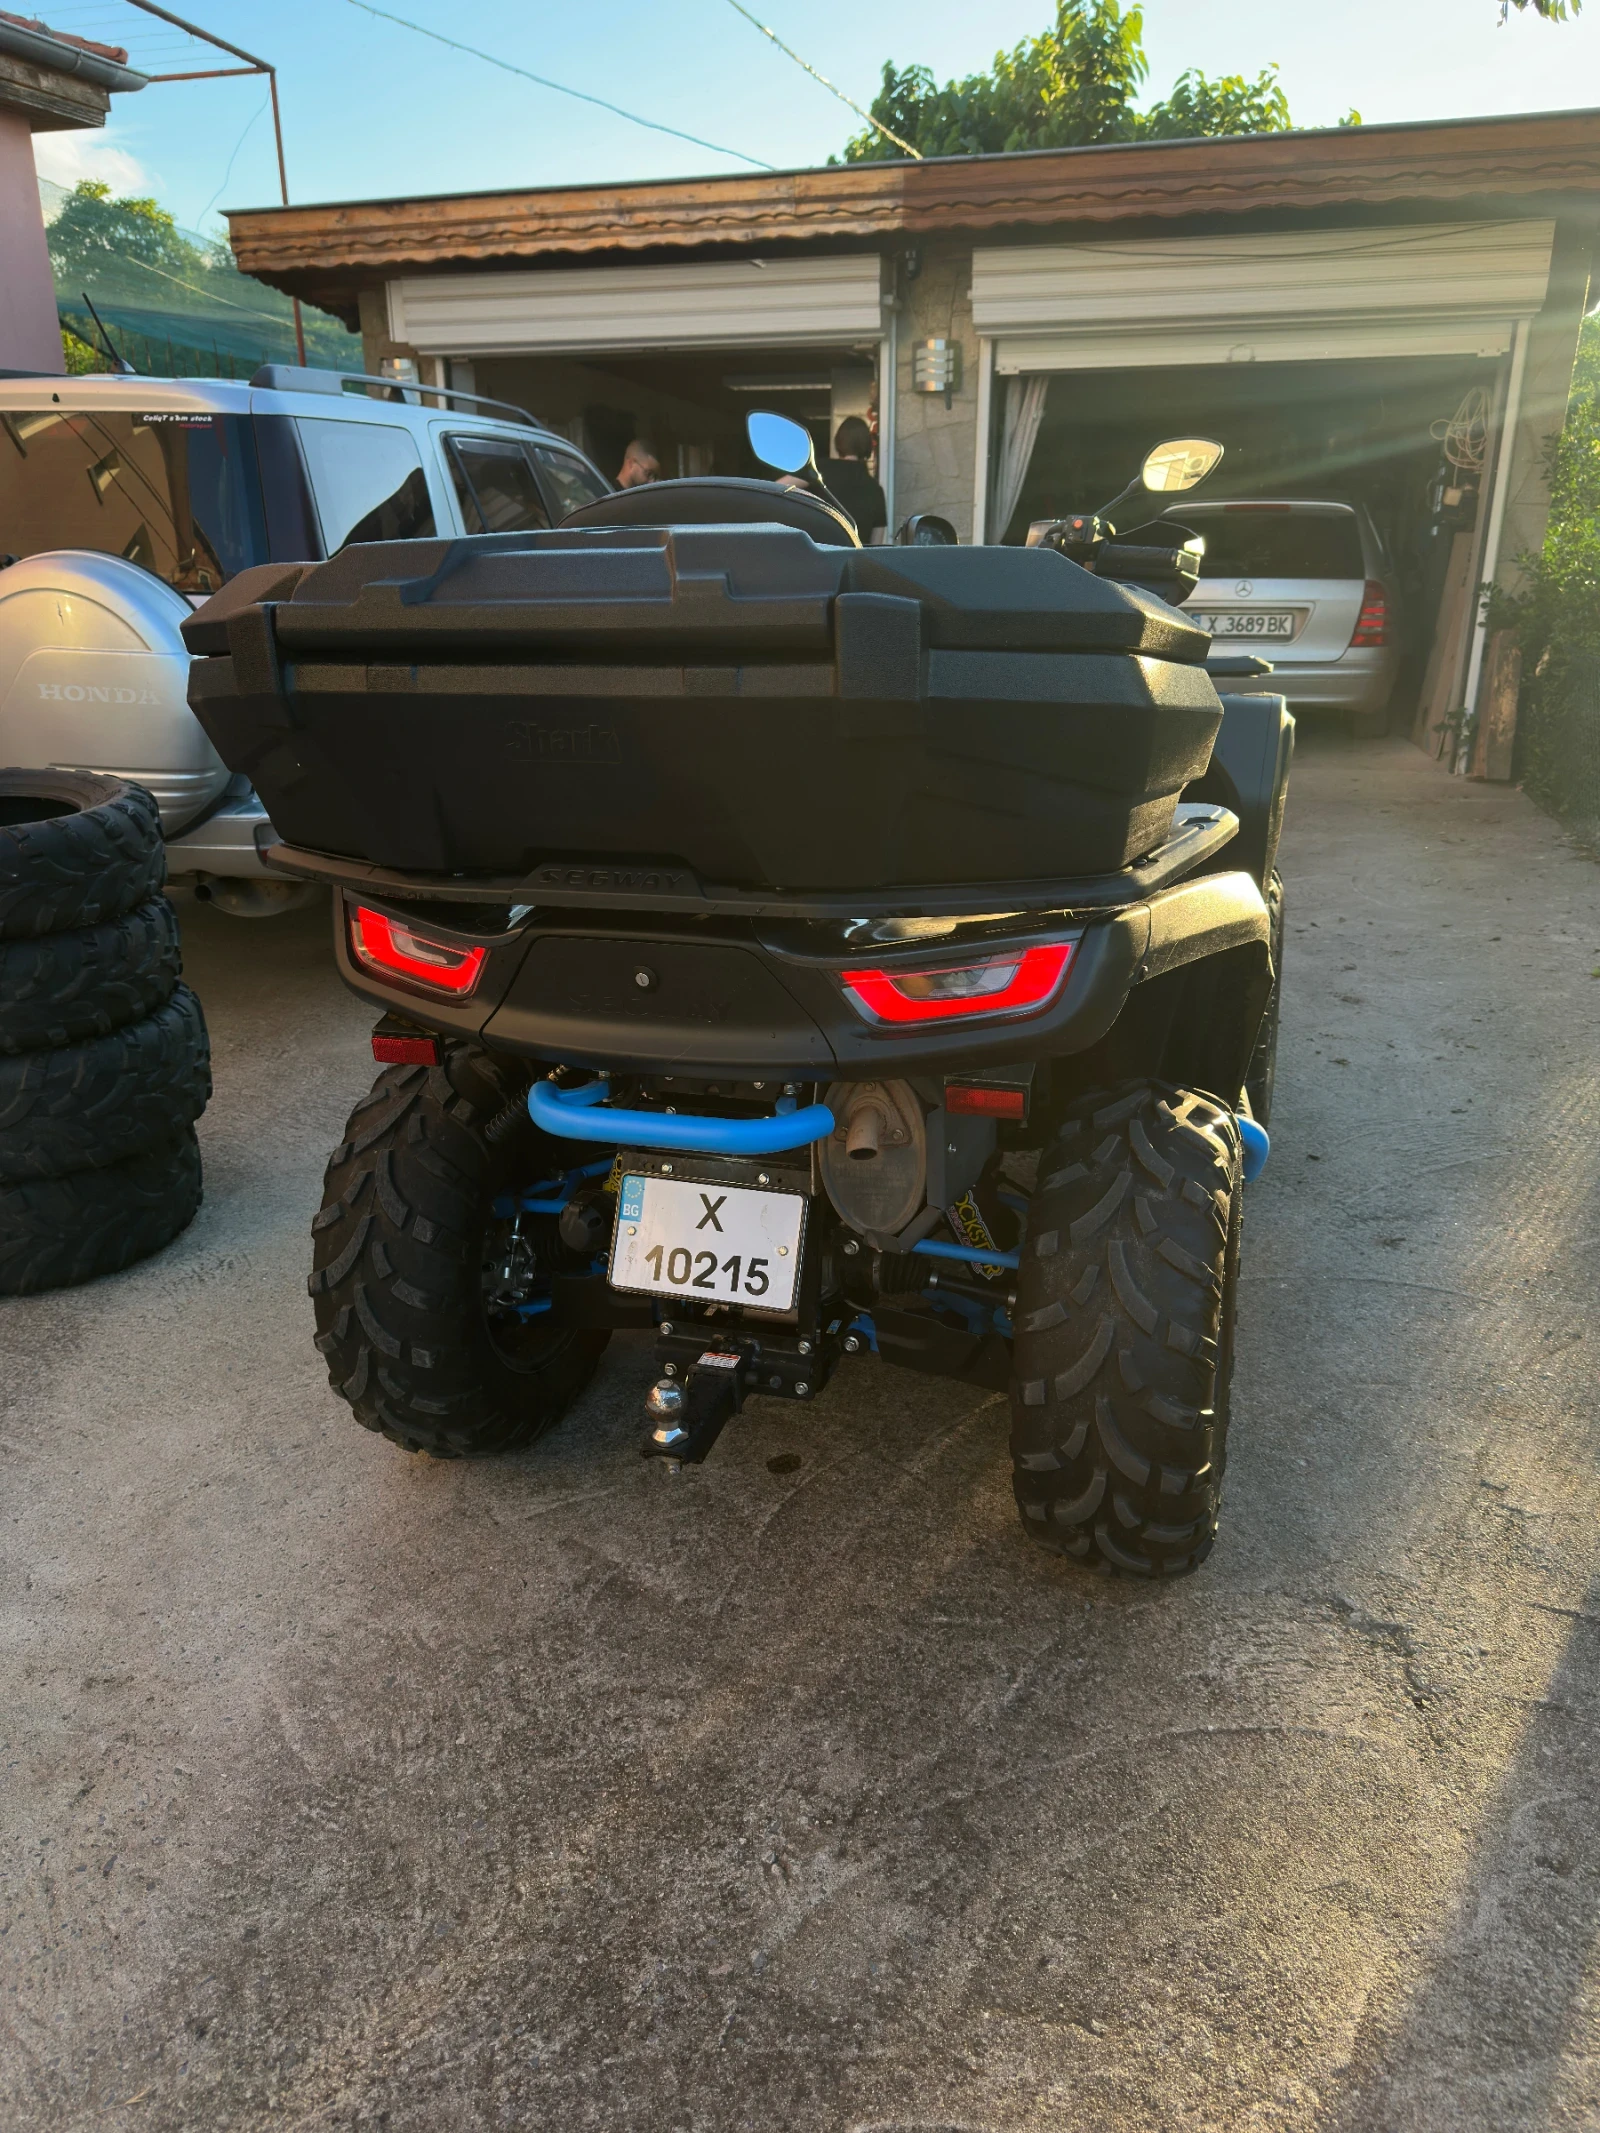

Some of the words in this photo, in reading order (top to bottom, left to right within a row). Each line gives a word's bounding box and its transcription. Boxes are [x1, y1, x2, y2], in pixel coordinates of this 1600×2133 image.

[36, 683, 161, 705] HONDA
[503, 720, 617, 756] Shark
[539, 868, 684, 889] SEGWAY
[622, 1203, 639, 1217] BG
[695, 1193, 727, 1232] X
[645, 1244, 770, 1296] 10215
